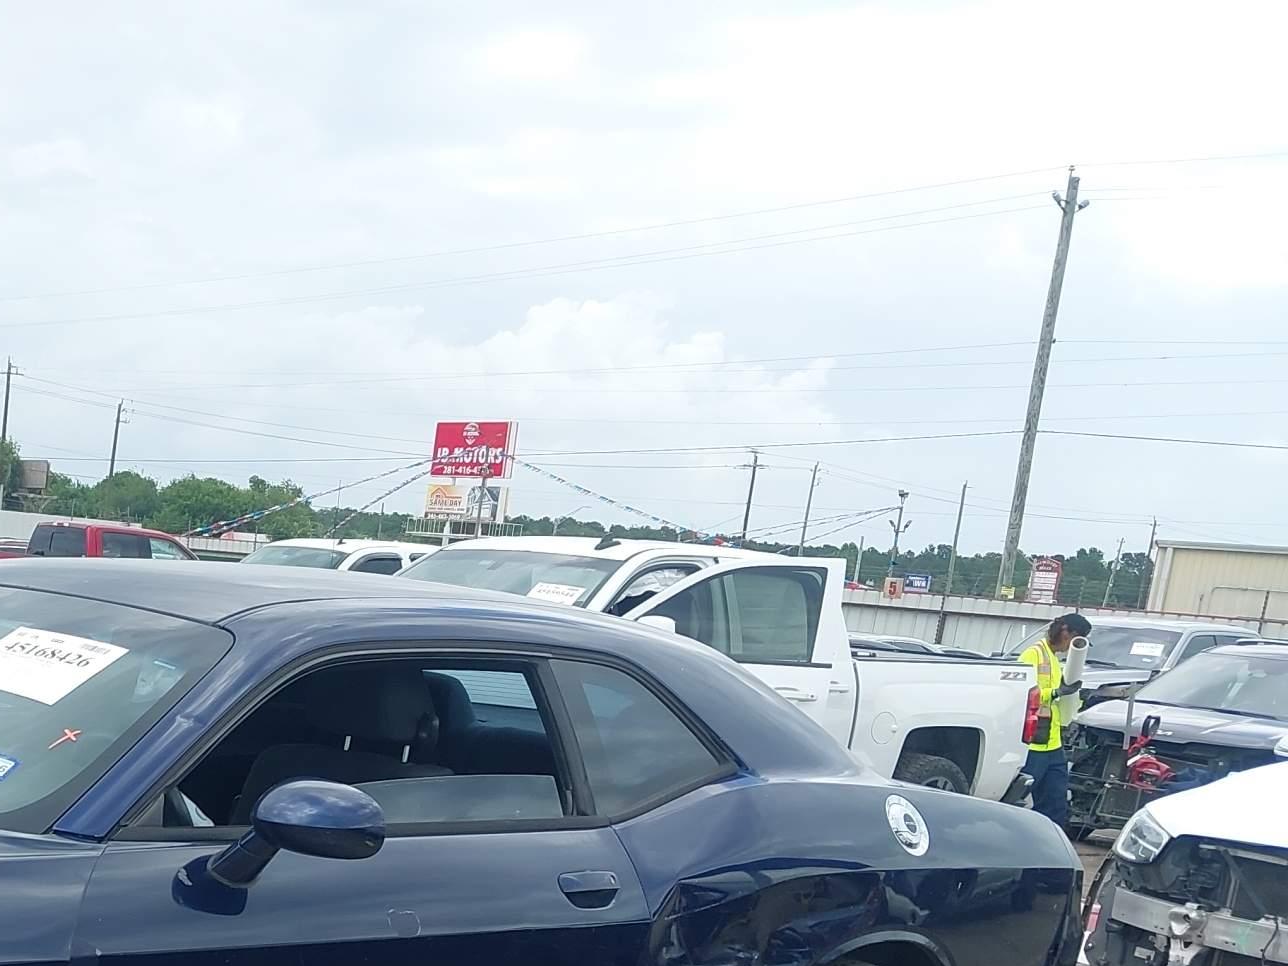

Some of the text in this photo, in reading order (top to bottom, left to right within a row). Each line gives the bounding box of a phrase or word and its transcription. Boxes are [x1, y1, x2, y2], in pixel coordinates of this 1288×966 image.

[450, 446, 503, 463] MOTORS
[443, 466, 490, 474] 281-416-4
[429, 498, 462, 507] SAME DAY
[888, 581, 897, 595] 5
[4, 641, 96, 667] 45168426
